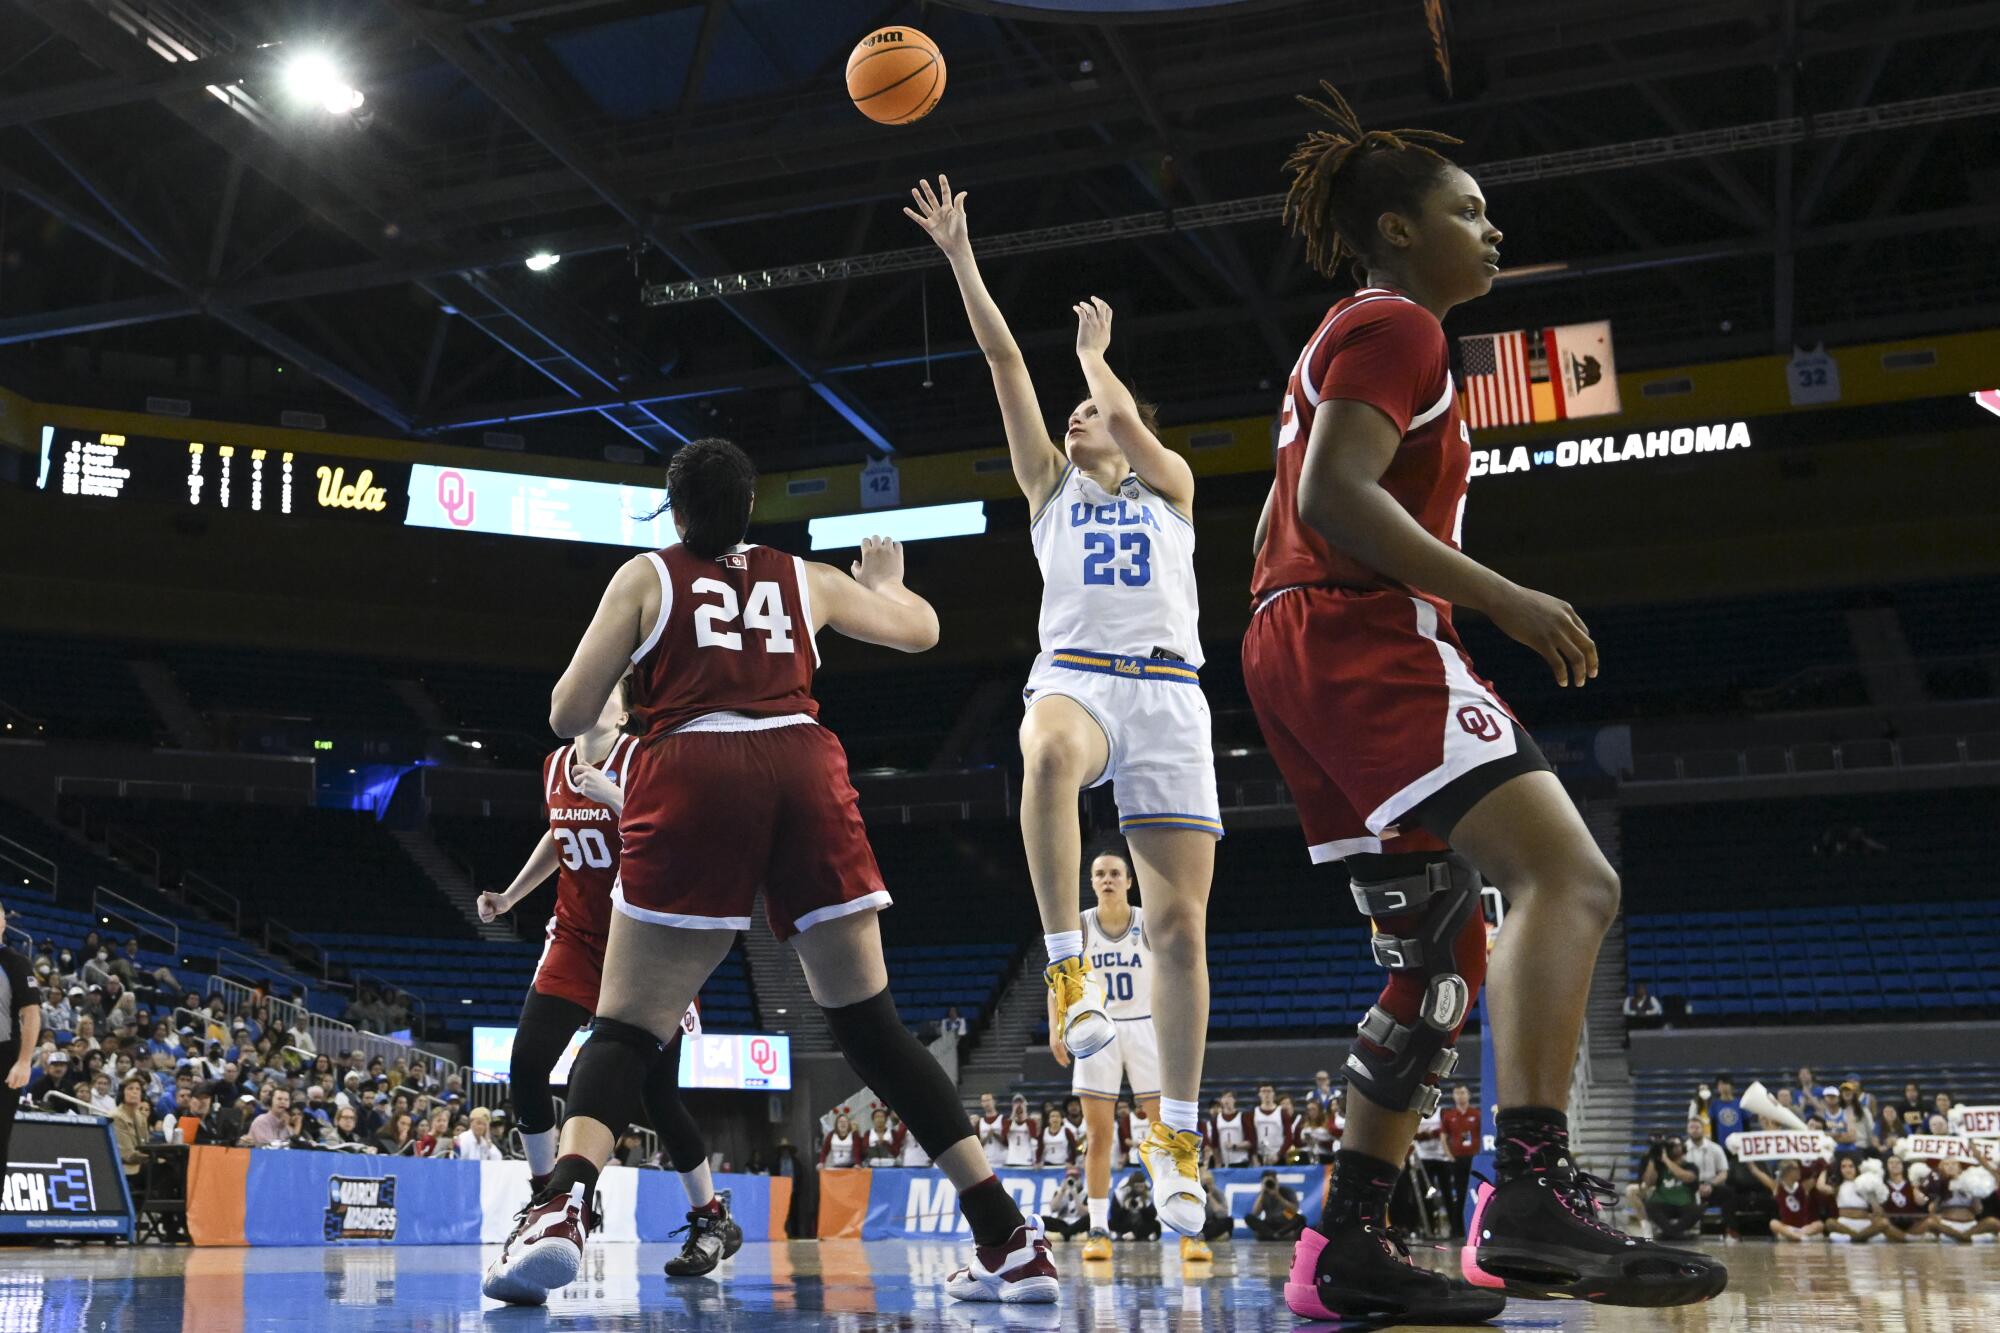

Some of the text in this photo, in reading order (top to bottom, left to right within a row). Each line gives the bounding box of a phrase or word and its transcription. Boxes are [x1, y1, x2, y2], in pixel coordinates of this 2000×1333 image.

[1798, 368, 1827, 387] 32
[1467, 446, 1530, 480] CLA
[1556, 422, 1751, 467] OKLAHOMA
[316, 465, 387, 512] Ucla
[869, 475, 891, 493] 42
[438, 471, 475, 527] OU
[1071, 500, 1162, 533] UCLA
[1083, 532, 1152, 587] 23
[691, 577, 795, 653] 24
[1456, 706, 1503, 742] OU
[553, 827, 613, 871] 30
[1091, 952, 1142, 969] UCLA
[1104, 972, 1134, 1001] 10
[684, 1011, 695, 1032] OU
[751, 1038, 777, 1075] OU
[1963, 1110, 2000, 1132] DEF
[1741, 1135, 1822, 1156] DEFENSE
[1913, 1138, 1993, 1161] DEFENE
[341, 1181, 379, 1206] MARCH
[343, 1206, 397, 1231] MADNESS
